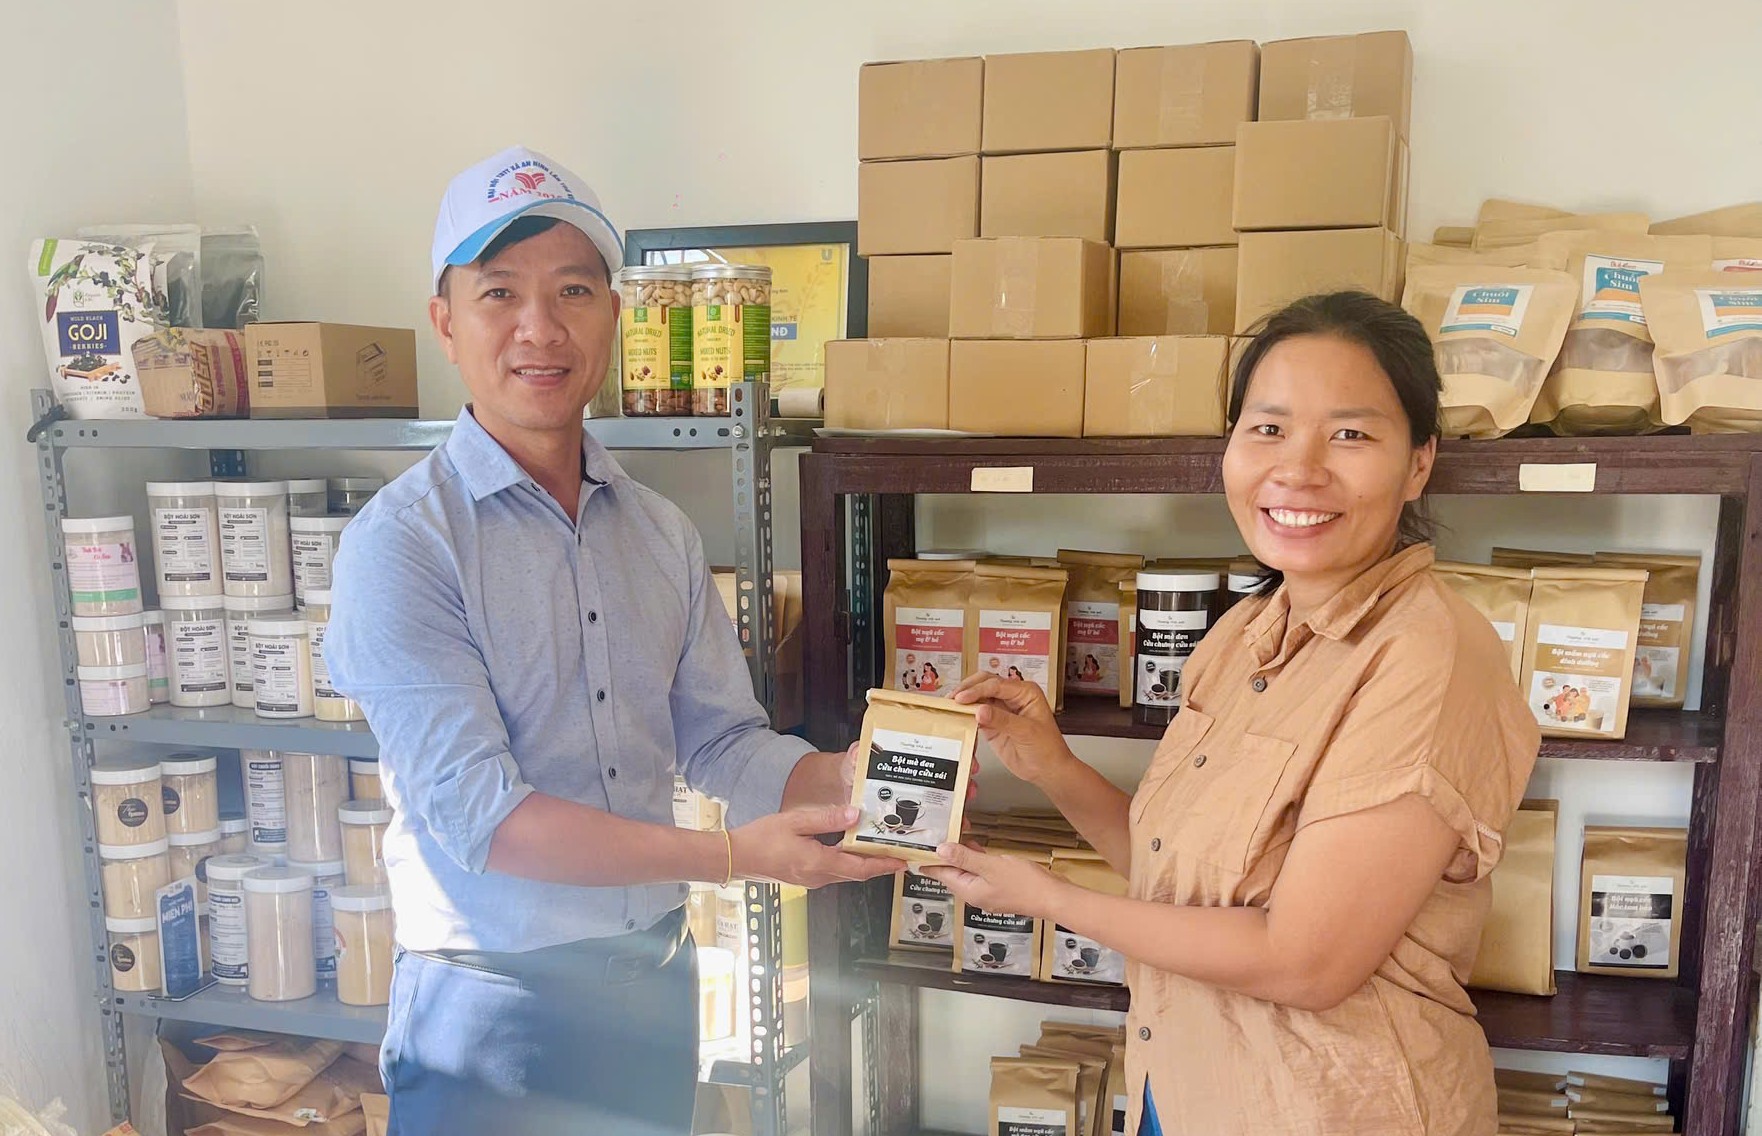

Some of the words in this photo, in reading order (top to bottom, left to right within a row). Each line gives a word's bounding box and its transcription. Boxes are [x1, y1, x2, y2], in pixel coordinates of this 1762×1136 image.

[68, 323, 107, 340] GOJI
[1152, 632, 1163, 640] Bột
[892, 755, 906, 765] Bột
[906, 758, 919, 766] mè
[920, 760, 935, 768] đen
[876, 762, 892, 771] Cửu
[893, 766, 918, 777] chưng
[918, 769, 934, 778] cửu
[934, 772, 948, 780] sái
